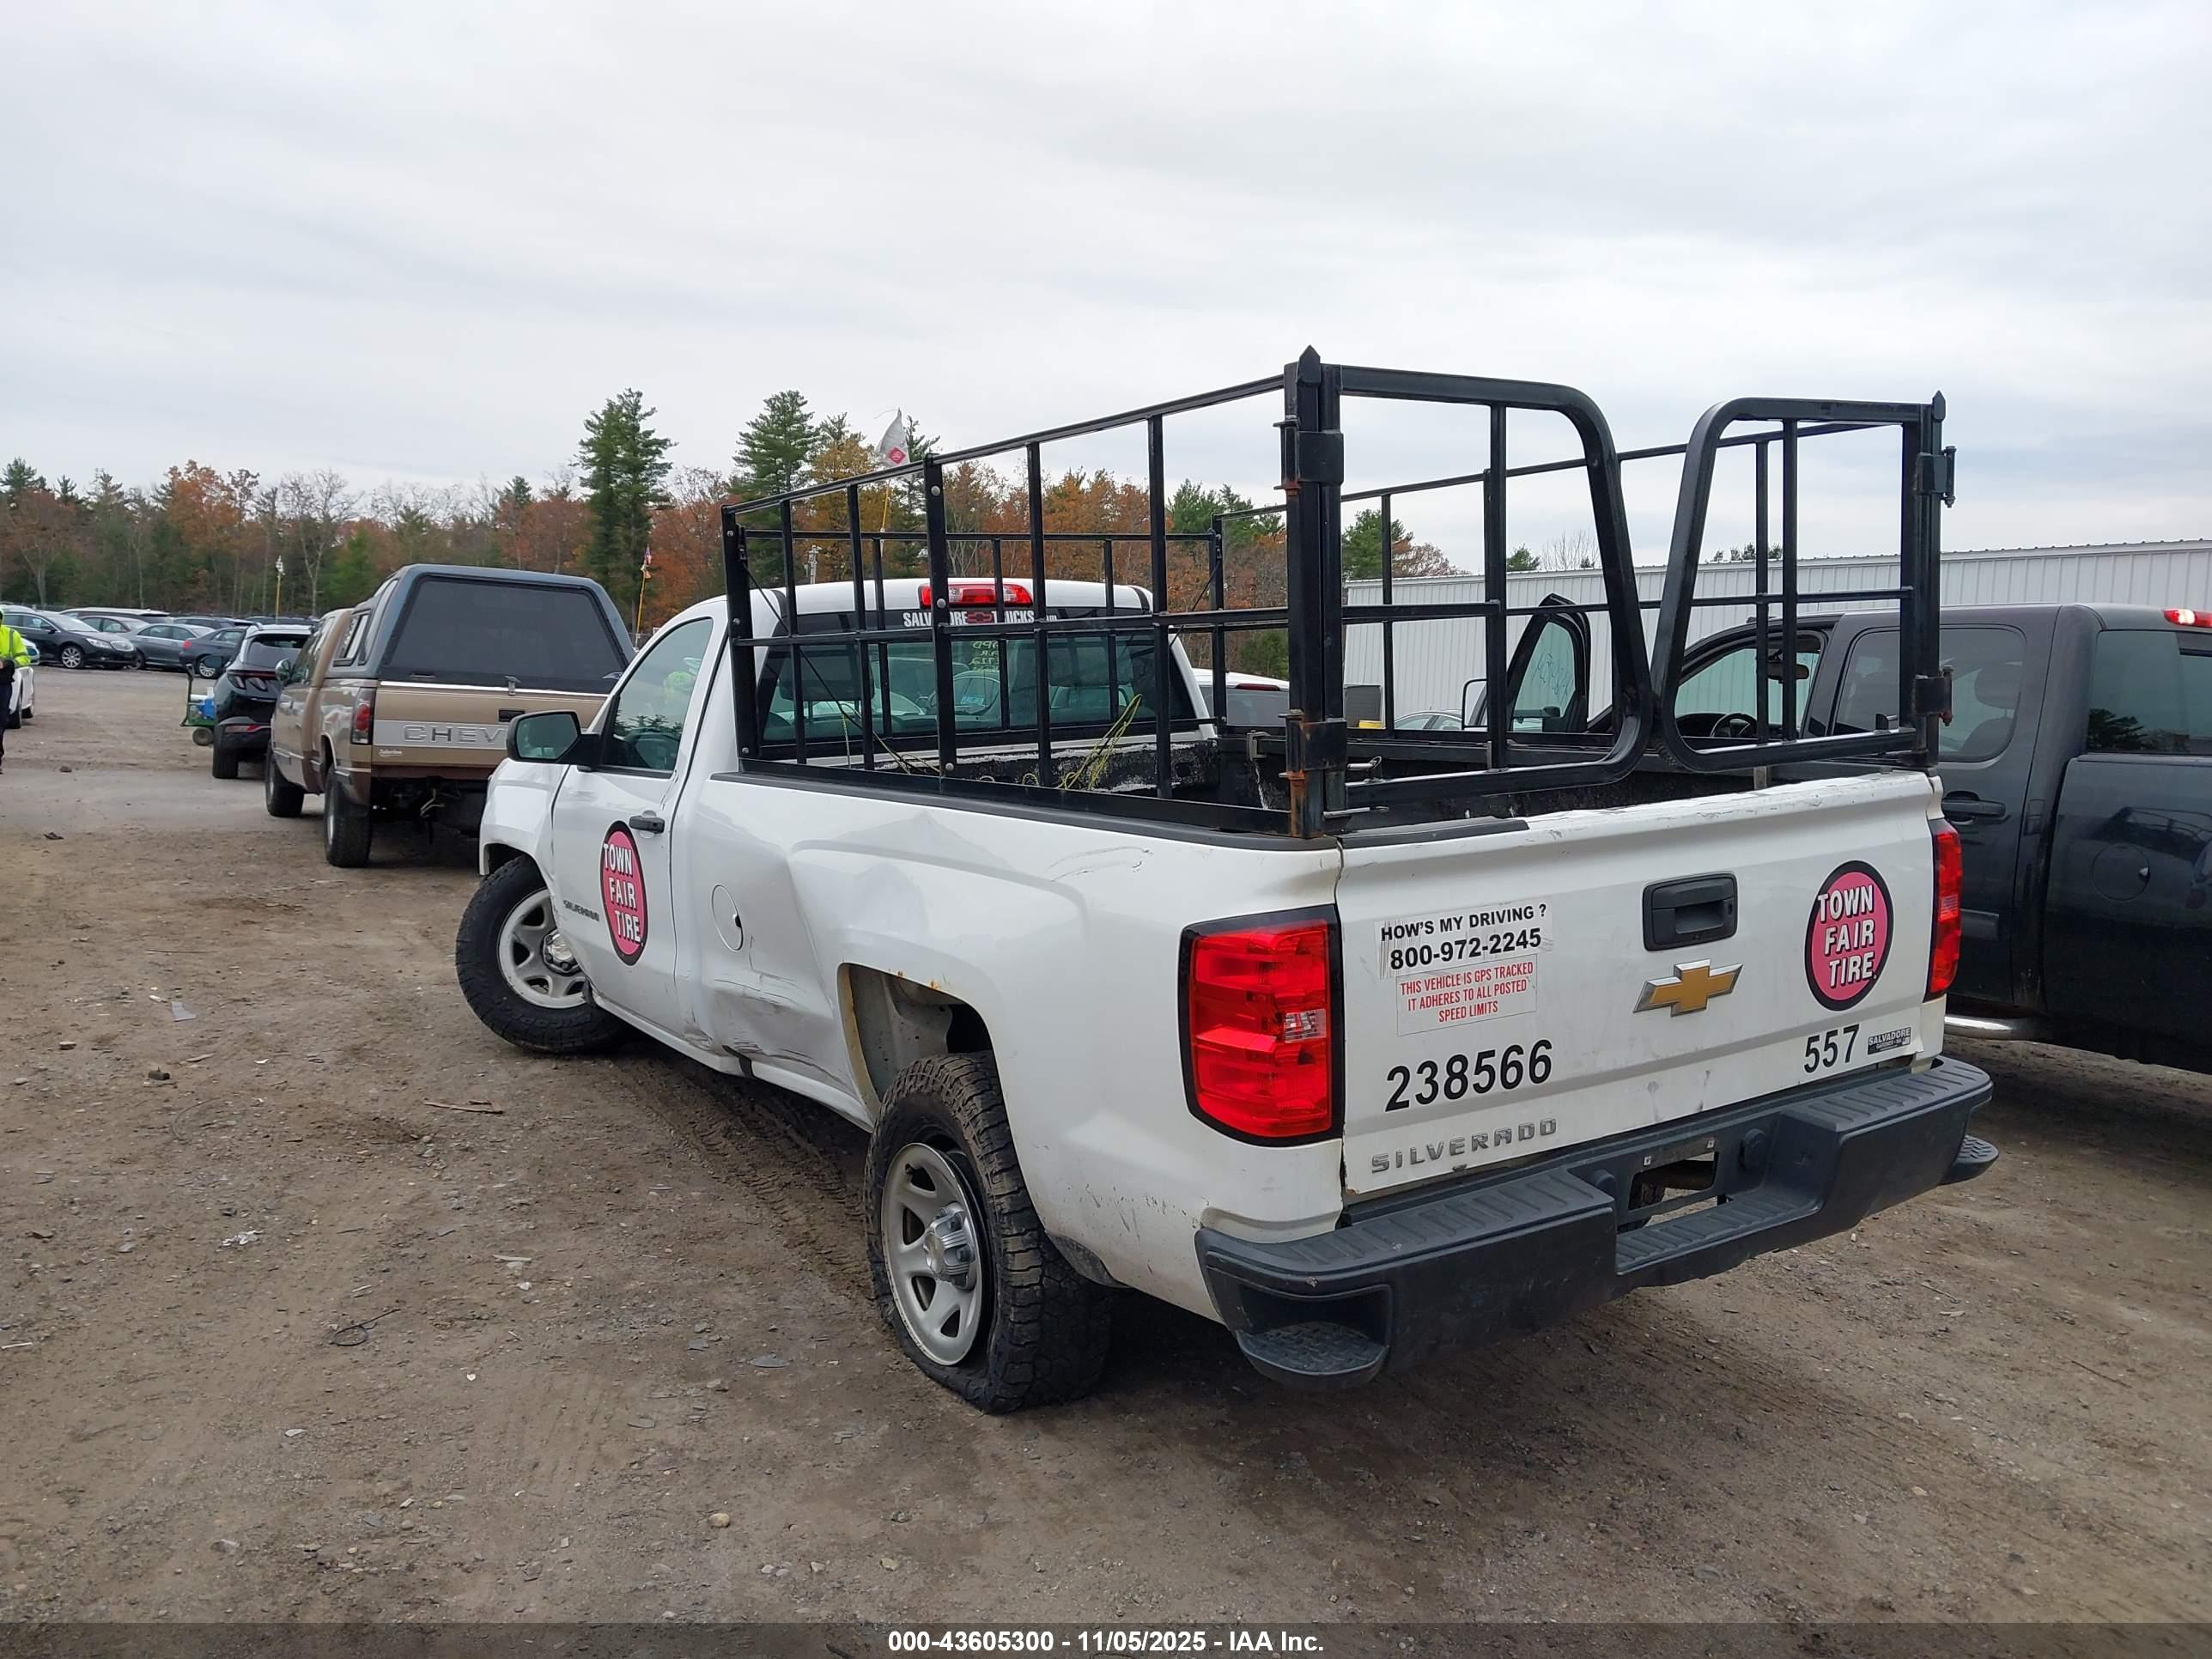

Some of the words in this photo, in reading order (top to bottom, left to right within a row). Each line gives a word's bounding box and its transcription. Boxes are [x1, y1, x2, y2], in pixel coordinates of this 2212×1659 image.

[603, 842, 634, 877] TOWN
[608, 877, 637, 911] FAIR
[1818, 884, 1875, 923] TOWN
[614, 910, 641, 943] TIRE
[1439, 915, 1464, 933] MY
[1469, 905, 1534, 928] DRIVING
[1539, 903, 1547, 917] ?
[1390, 927, 1541, 970] 800-972-2245
[1824, 919, 1875, 956] FAIR
[1401, 981, 1422, 996] THIS
[1424, 975, 1461, 991] VEHICLE
[1463, 972, 1473, 985] IS
[1474, 968, 1492, 983] GPS
[1494, 961, 1534, 979] TRACKED
[1829, 951, 1875, 988] TIRE
[1407, 999, 1418, 1012] IT
[1419, 990, 1461, 1010] ADHERES
[1463, 988, 1474, 1002] TO
[1476, 985, 1492, 1000] ALL
[1494, 979, 1528, 996] POSTED
[1438, 1008, 1468, 1023] SPEED
[1469, 1000, 1498, 1018] LIMITS
[1803, 1024, 1860, 1073] 557
[1869, 1028, 1911, 1045] SALVADORE
[1385, 1039, 1553, 1112] 238566
[1371, 1118, 1557, 1174] SILVERADO
